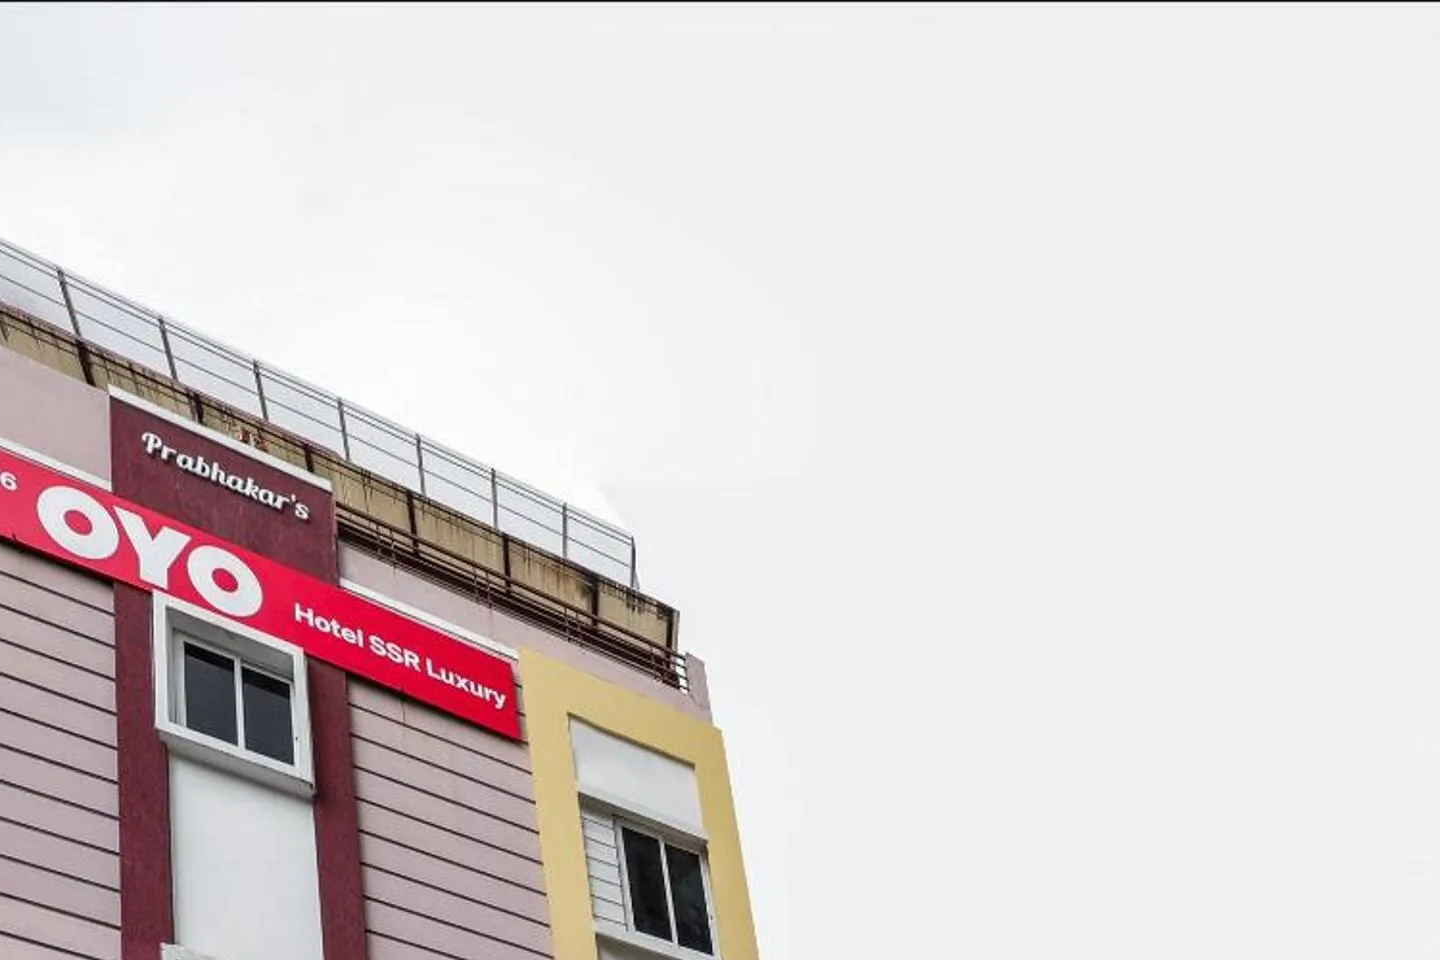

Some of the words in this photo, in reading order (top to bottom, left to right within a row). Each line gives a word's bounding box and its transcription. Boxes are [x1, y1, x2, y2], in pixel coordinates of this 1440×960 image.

[141, 431, 310, 520] Prabhakar's
[36, 485, 263, 617] OYO
[294, 602, 364, 647] Hotel
[368, 634, 421, 672] SSR
[426, 657, 507, 710] Luxury
